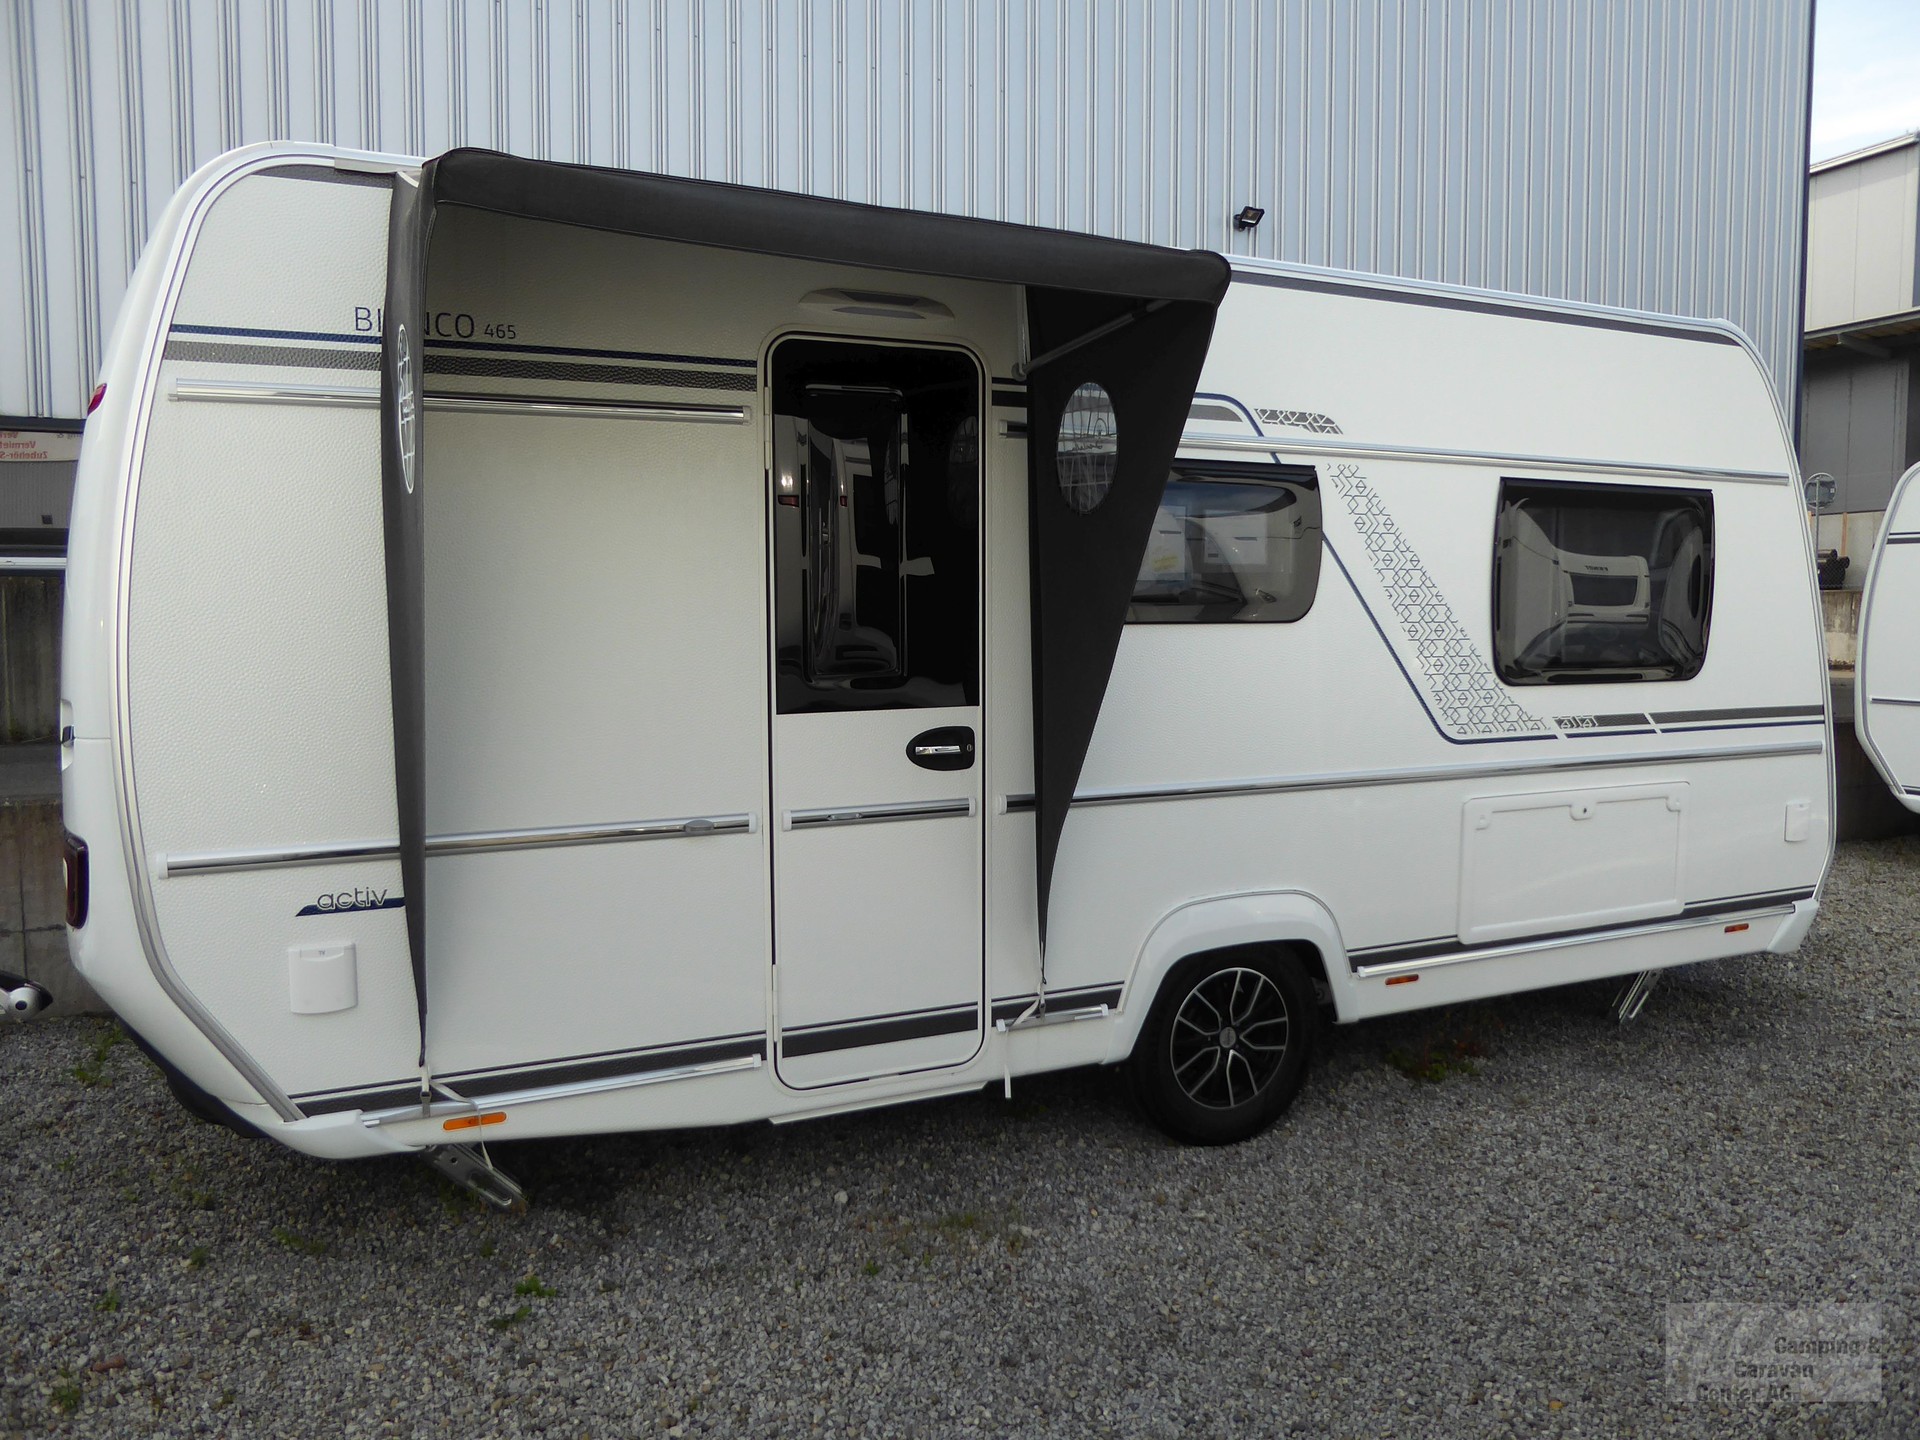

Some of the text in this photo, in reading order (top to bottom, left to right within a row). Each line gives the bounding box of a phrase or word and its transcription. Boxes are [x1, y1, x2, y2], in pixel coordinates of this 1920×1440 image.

[354, 306, 516, 339] BICO 465
[317, 886, 388, 910] activ
